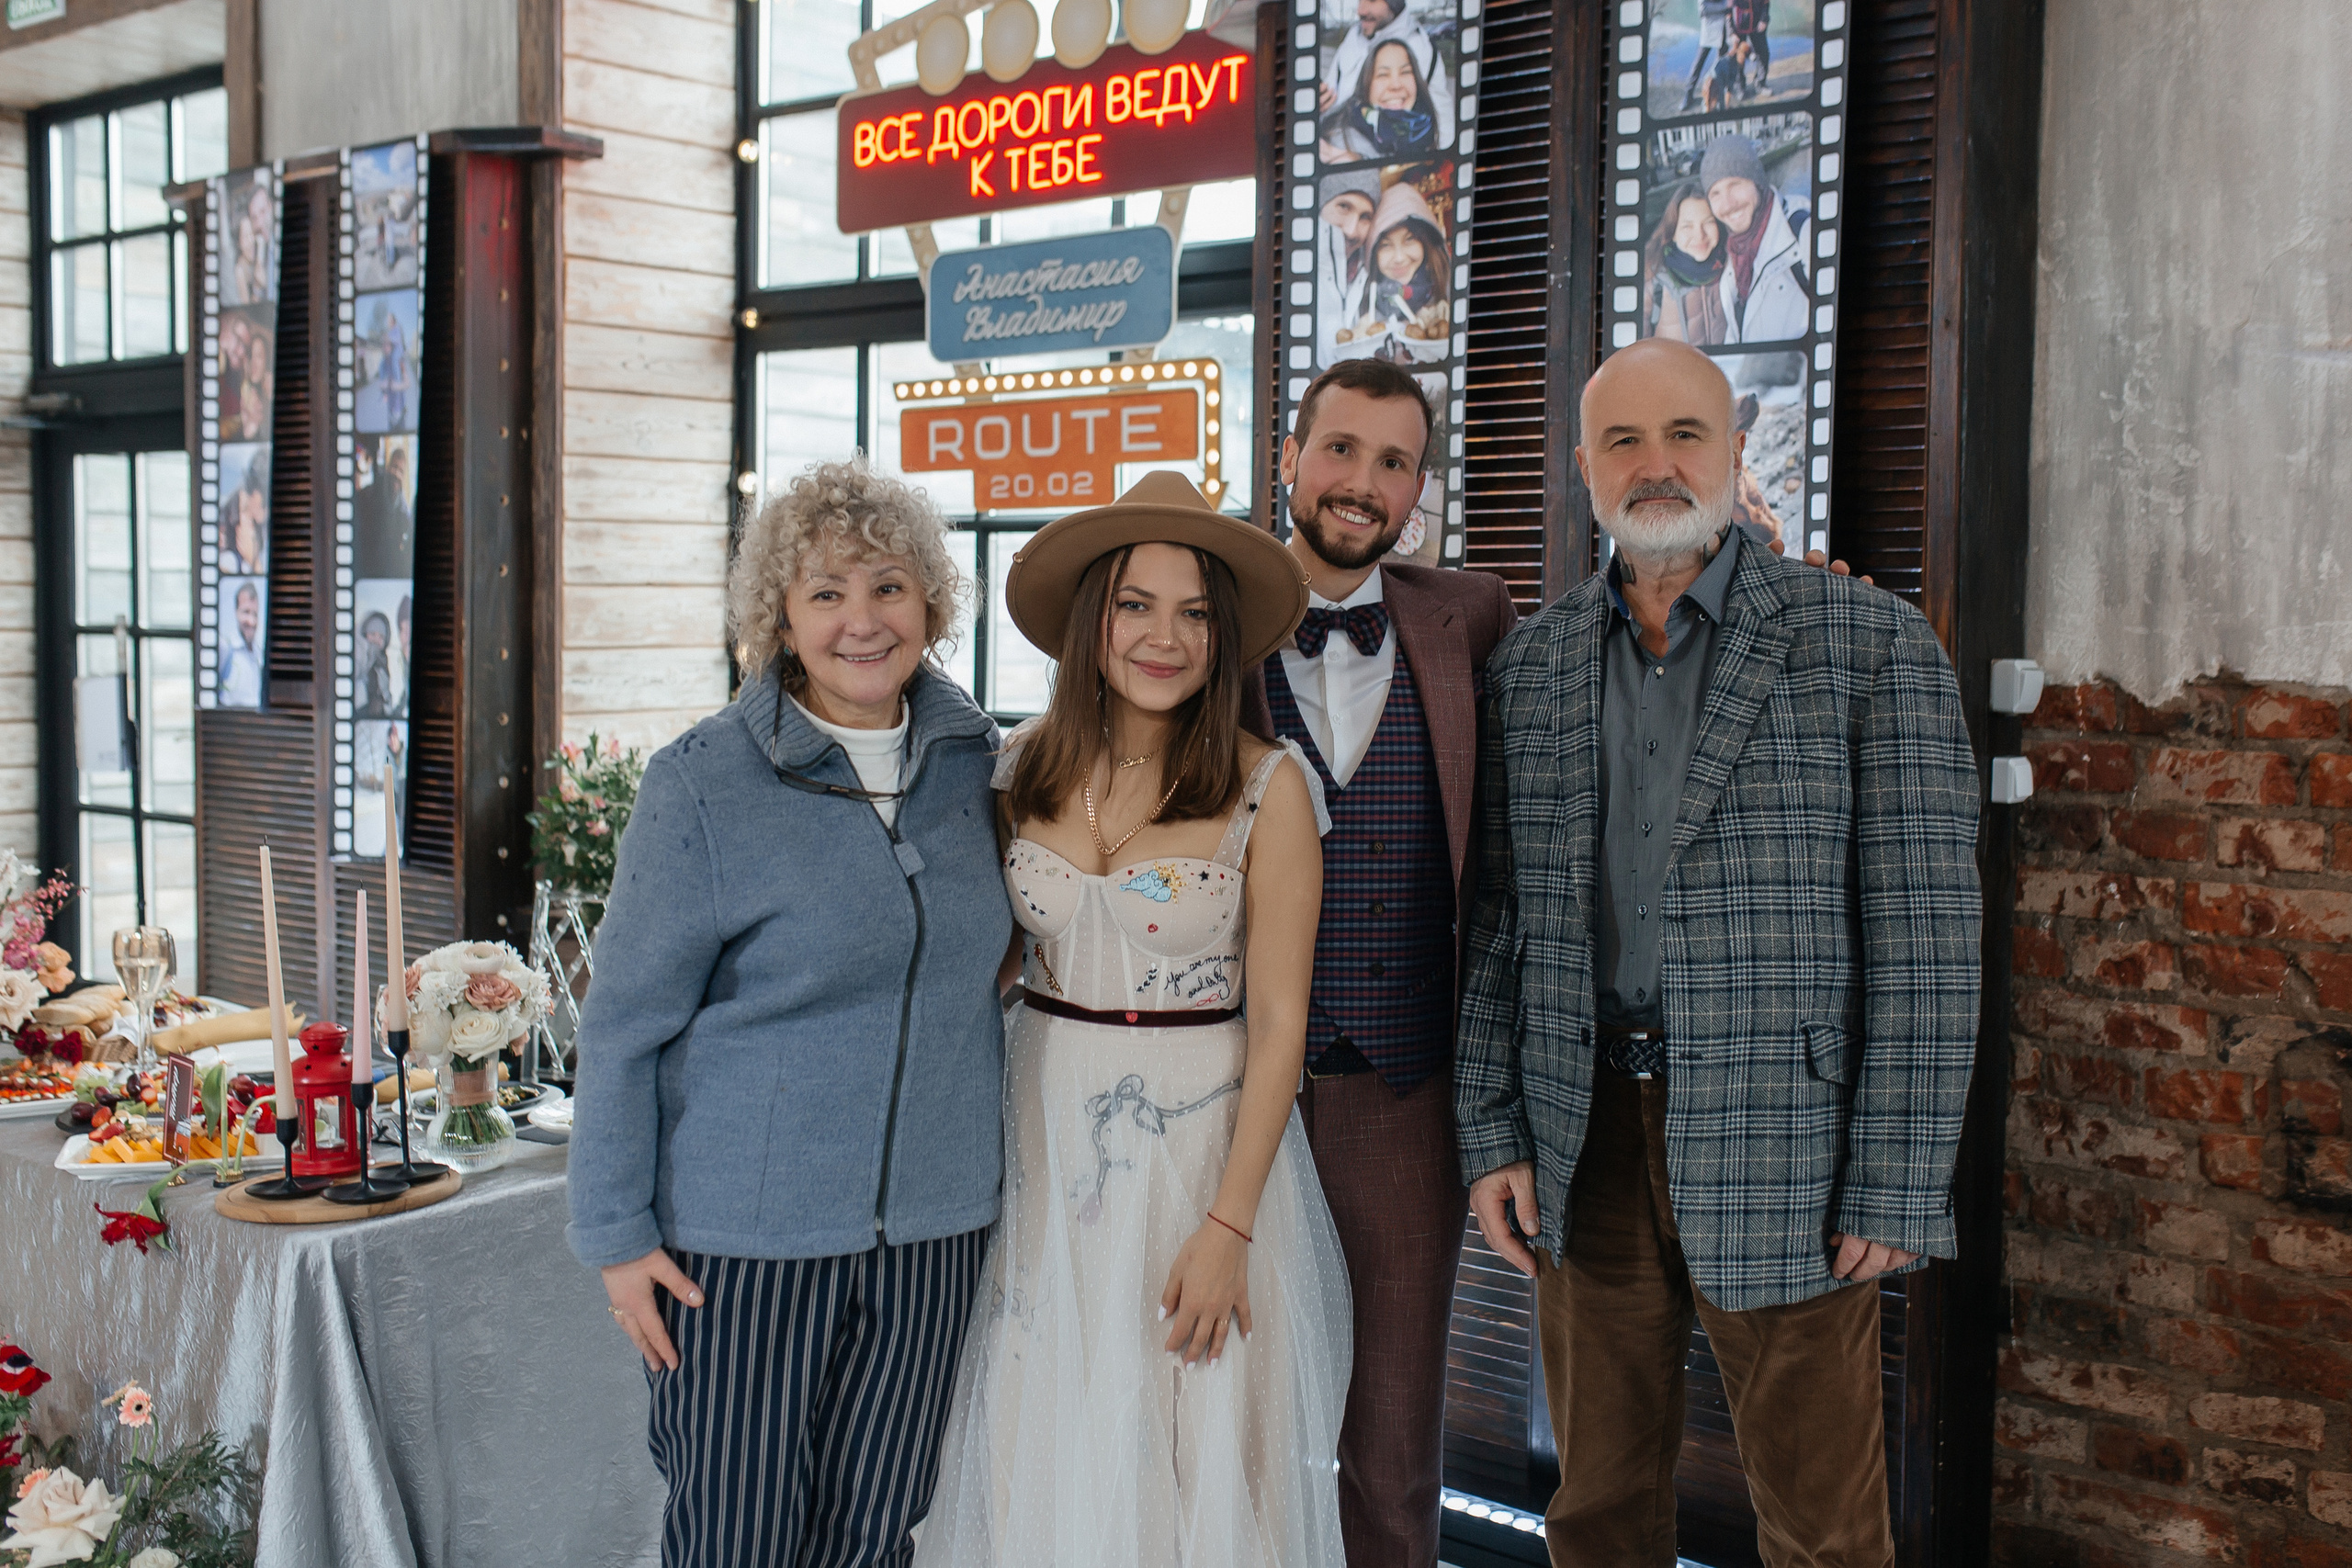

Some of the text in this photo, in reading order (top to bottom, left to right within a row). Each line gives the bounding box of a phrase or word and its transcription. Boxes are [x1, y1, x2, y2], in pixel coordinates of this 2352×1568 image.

[853, 54, 1249, 168] ВСЕ ДОРОГИ ВЕДУТ
[970, 133, 1103, 197] К ТЕБЕ
[953, 255, 1145, 304] Анастасия
[962, 296, 1127, 343] Владимир
[928, 405, 1163, 463] ROUTE
[989, 470, 1094, 499] 20.02
[1164, 953, 1239, 997] You are my one
[1188, 976, 1207, 998] and
